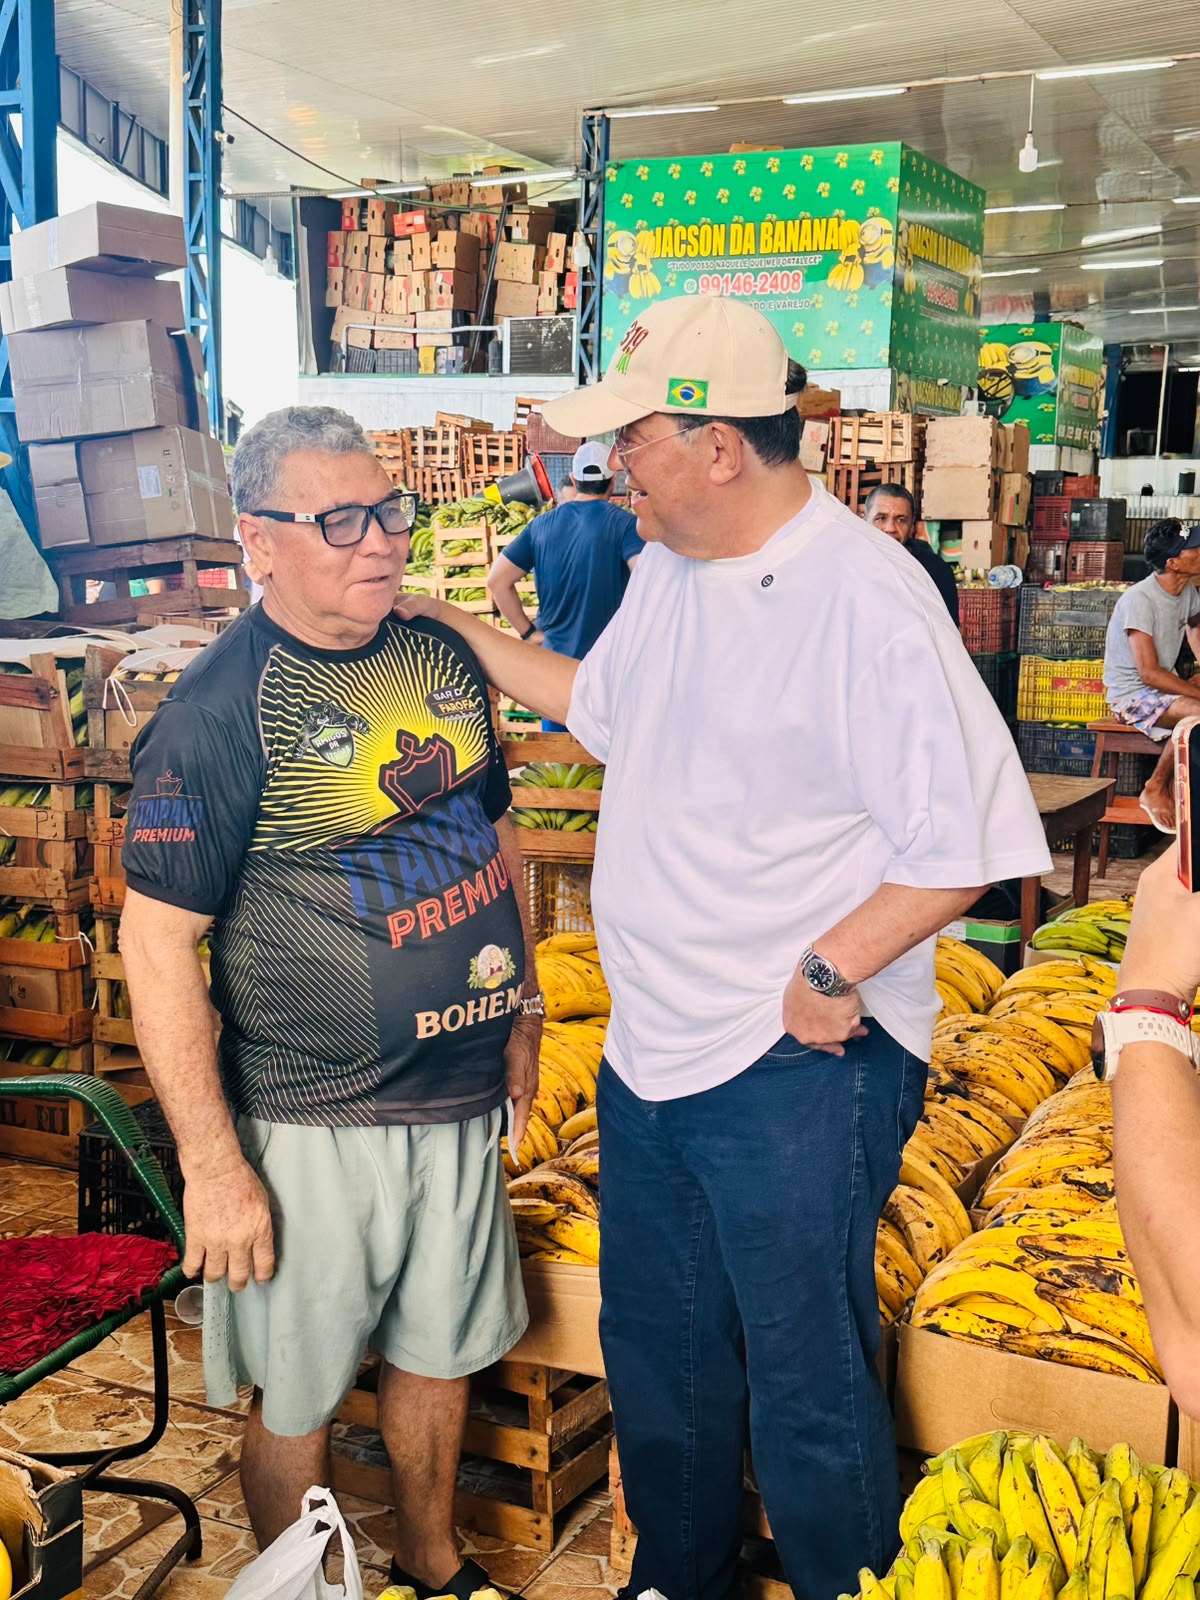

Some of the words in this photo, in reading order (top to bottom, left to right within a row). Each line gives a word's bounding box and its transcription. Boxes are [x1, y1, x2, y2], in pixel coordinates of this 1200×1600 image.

[654, 224, 726, 259] JACSON
[729, 222, 755, 256] DA
[760, 218, 840, 254] BANANA
[692, 262, 714, 271] POSSO
[716, 260, 749, 270] NAQUELE
[750, 259, 764, 268] QUE
[765, 259, 775, 268] ME
[700, 271, 802, 295] 99146-2408
[768, 302, 775, 310] E
[776, 300, 810, 310] VAREJO
[433, 690, 453, 700] BAR
[438, 699, 476, 713] FAROFA
[314, 730, 348, 748] AMIGOS
[132, 828, 196, 842] PREMIUM
[386, 851, 511, 949] PREMIU
[415, 981, 525, 1040] BOHEM
